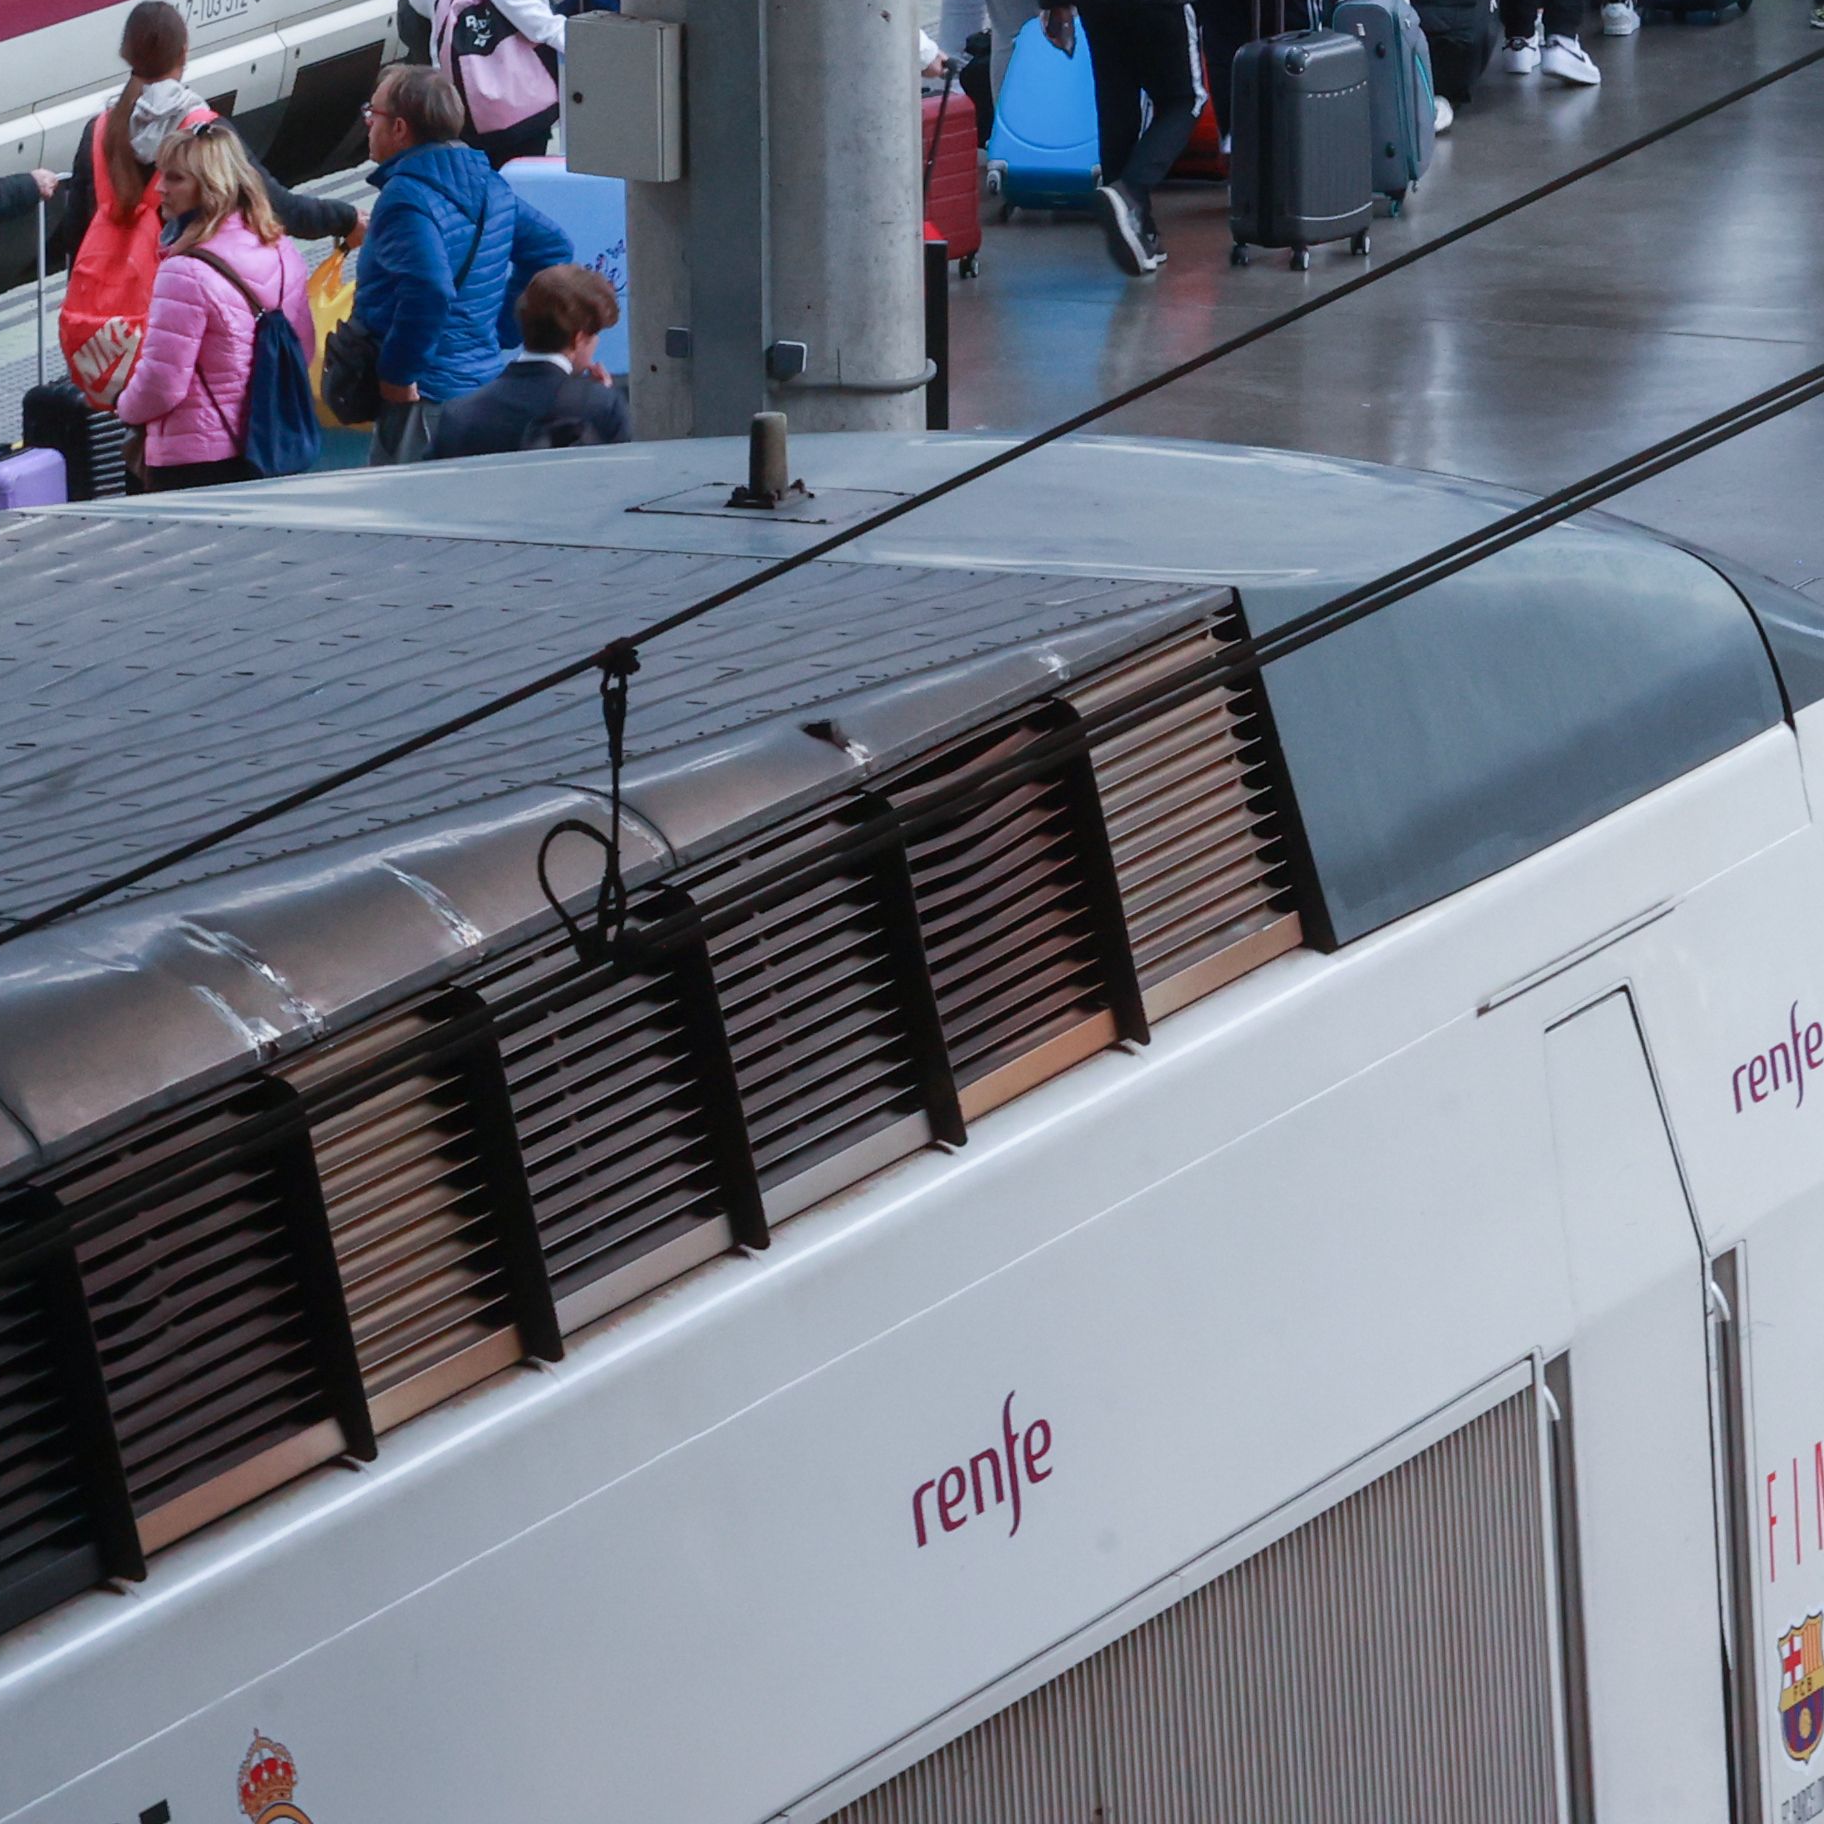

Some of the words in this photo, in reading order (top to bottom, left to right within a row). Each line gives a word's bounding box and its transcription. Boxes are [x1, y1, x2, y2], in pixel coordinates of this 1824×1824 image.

[72, 316, 129, 386] NIKE
[1732, 999, 1824, 1114] renfe
[912, 1389, 1053, 1549] renfe
[1792, 1675, 1814, 1702] FCB
